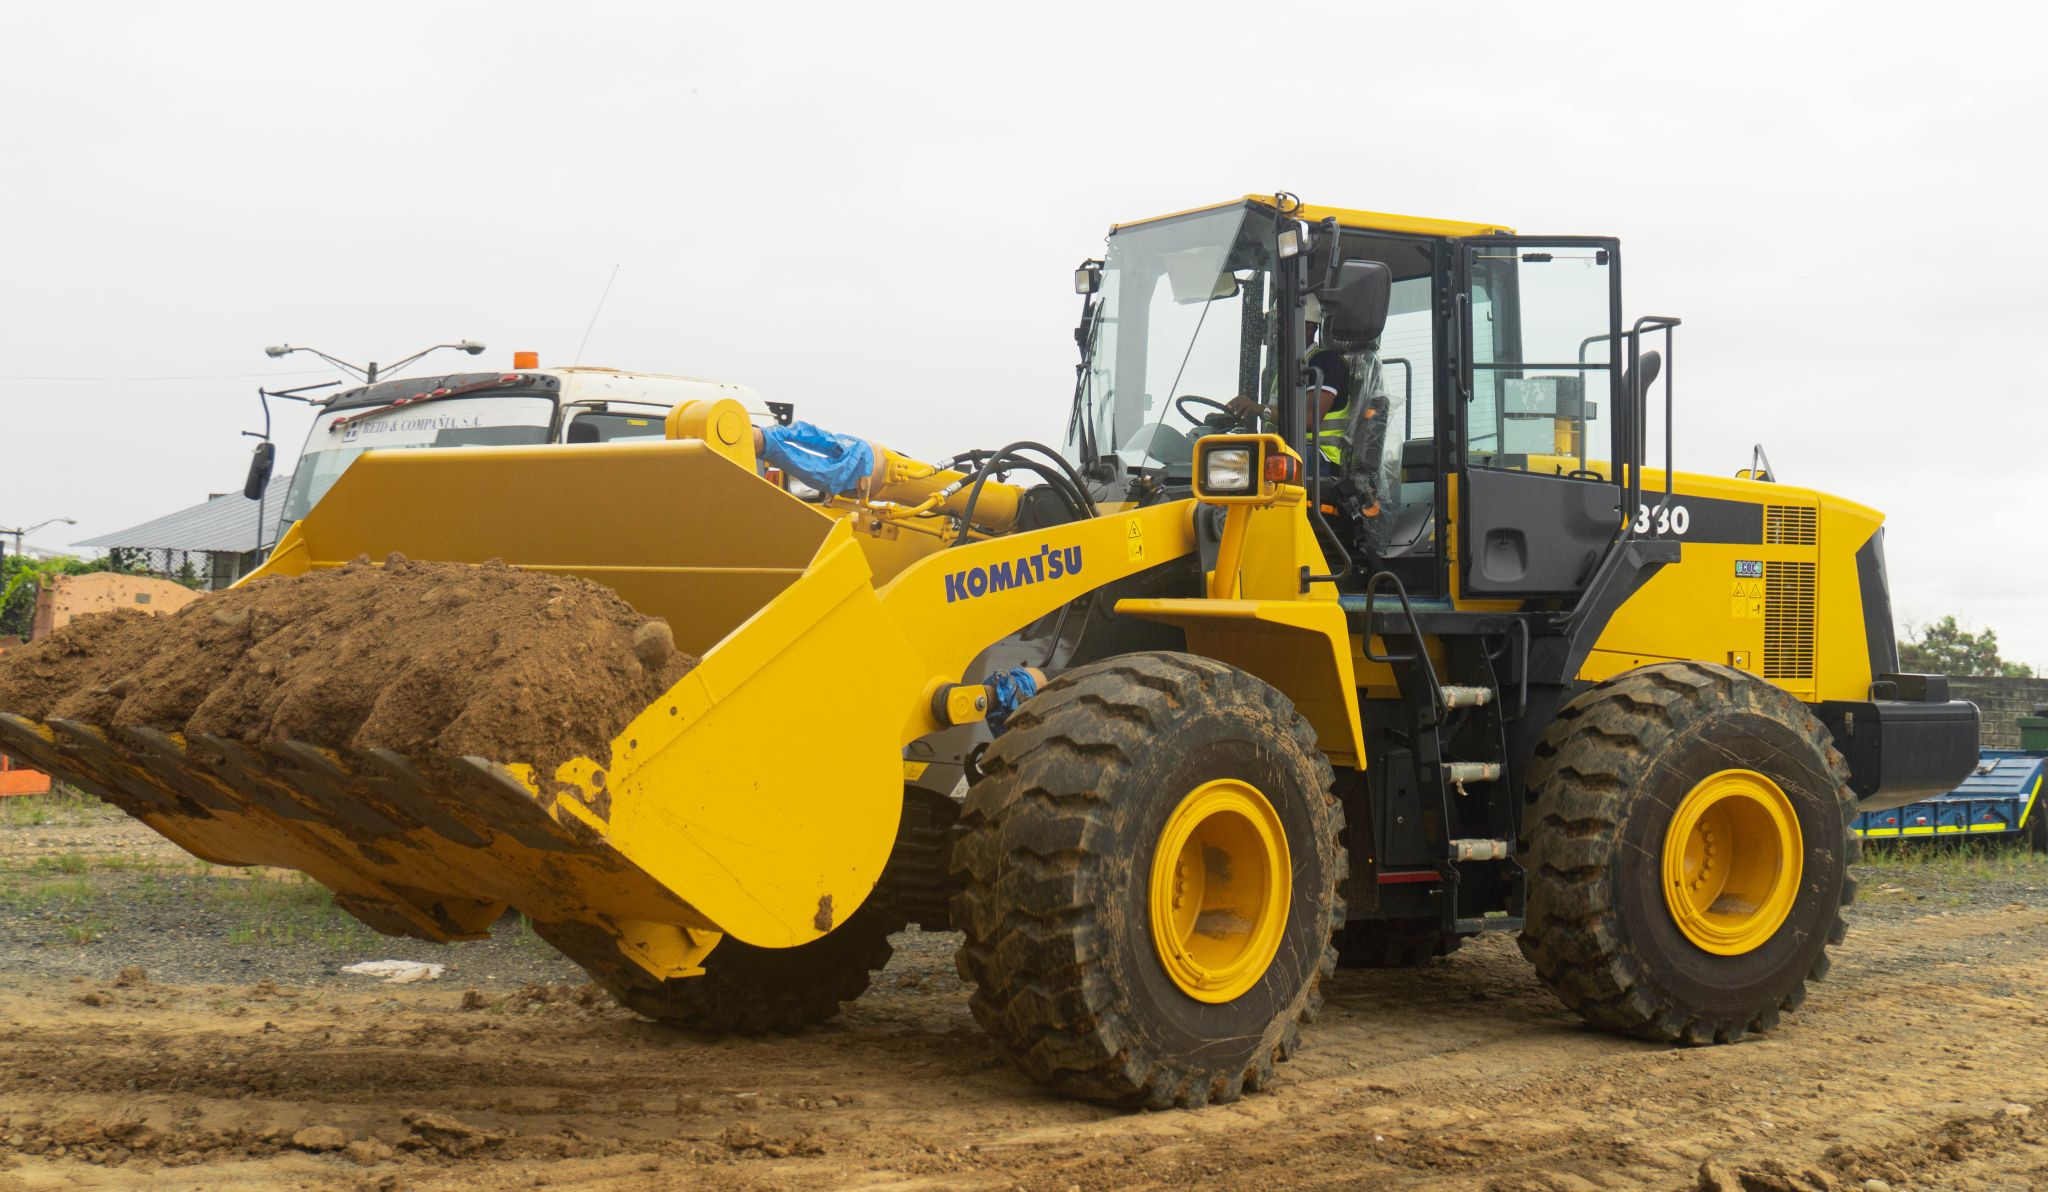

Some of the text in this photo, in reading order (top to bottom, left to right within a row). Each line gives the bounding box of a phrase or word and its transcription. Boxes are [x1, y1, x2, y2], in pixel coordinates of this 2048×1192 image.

[362, 421, 388, 434] REID
[389, 419, 398, 432] &
[945, 544, 1082, 603] KOMATSU
